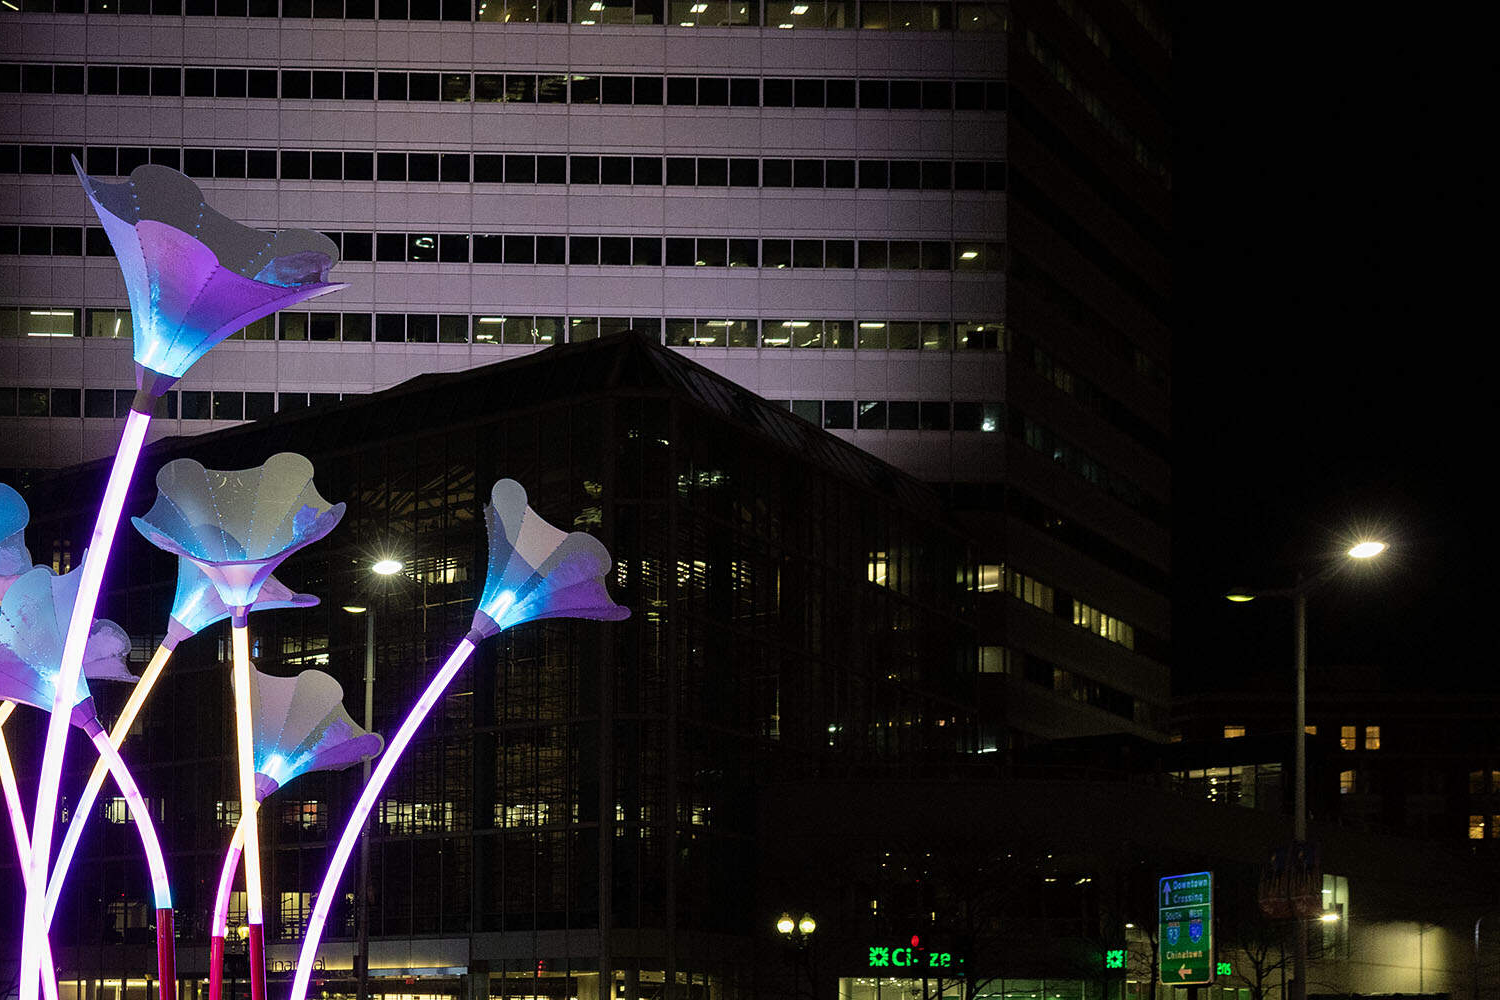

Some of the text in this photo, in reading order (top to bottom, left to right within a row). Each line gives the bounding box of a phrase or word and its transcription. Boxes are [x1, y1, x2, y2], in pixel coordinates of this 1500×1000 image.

[1173, 879, 1208, 890] Downtown
[1173, 893, 1203, 904] Crossing
[1166, 950, 1203, 960] Chinatown
